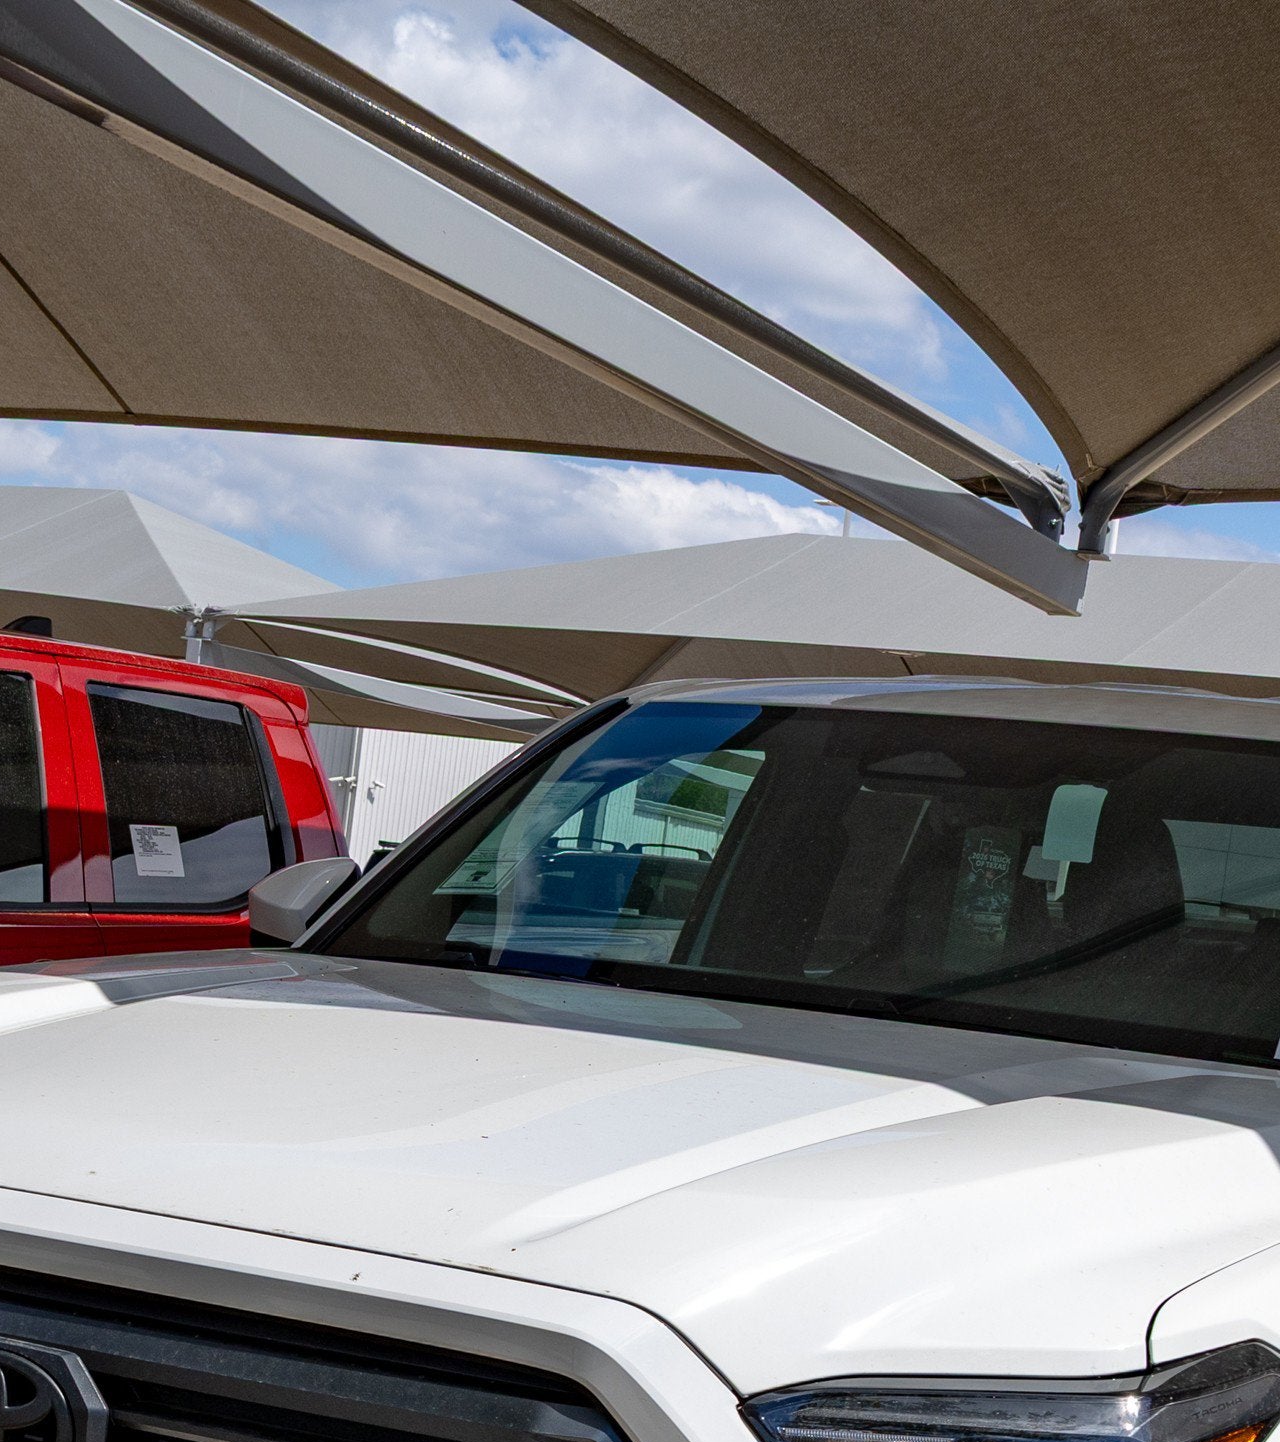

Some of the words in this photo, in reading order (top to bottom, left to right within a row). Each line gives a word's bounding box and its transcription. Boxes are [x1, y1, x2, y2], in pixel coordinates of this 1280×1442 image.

[989, 855, 1011, 865] TRUCK
[986, 861, 1007, 871] TEXAS
[1191, 1397, 1243, 1419] TACOMA
